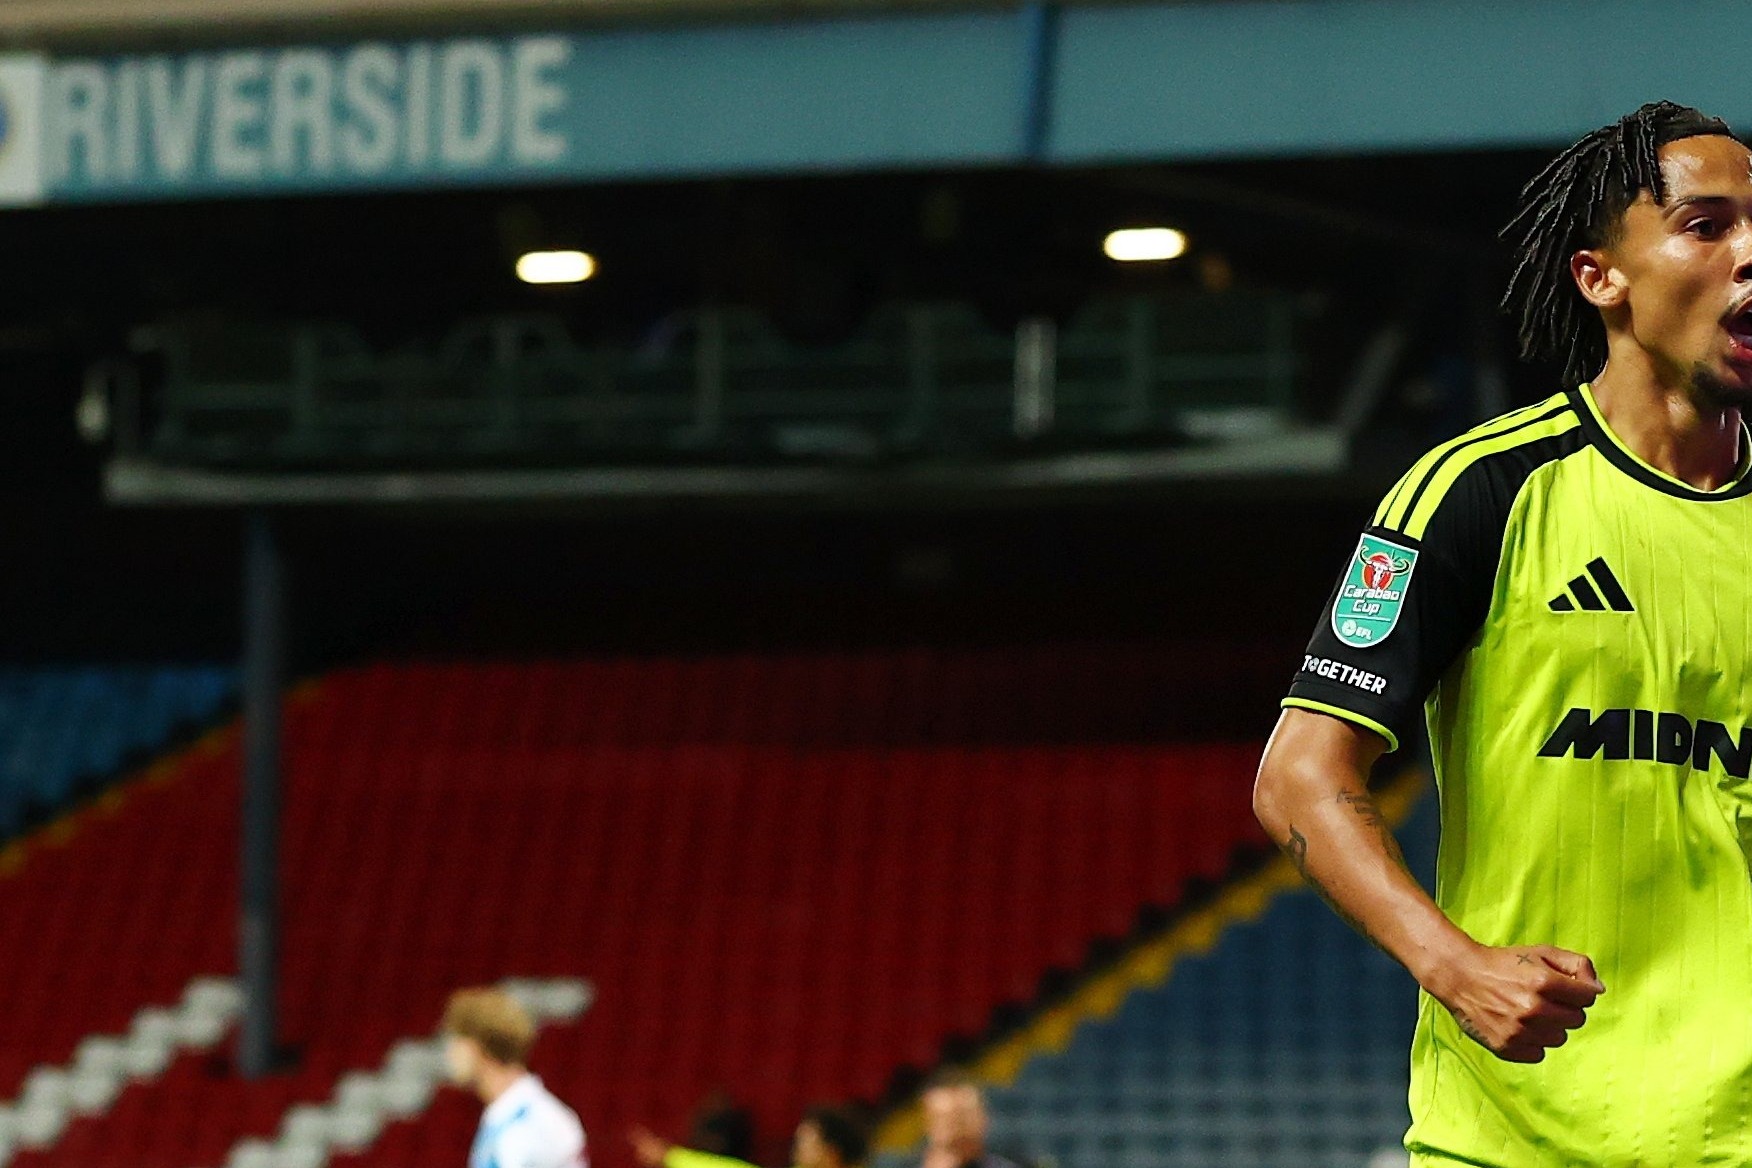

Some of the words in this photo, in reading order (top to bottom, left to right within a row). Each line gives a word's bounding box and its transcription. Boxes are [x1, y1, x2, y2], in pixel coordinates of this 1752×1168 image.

[50, 33, 573, 182] RIVERSIDE
[1343, 584, 1401, 601] Carabao
[1352, 599, 1381, 616] Cup
